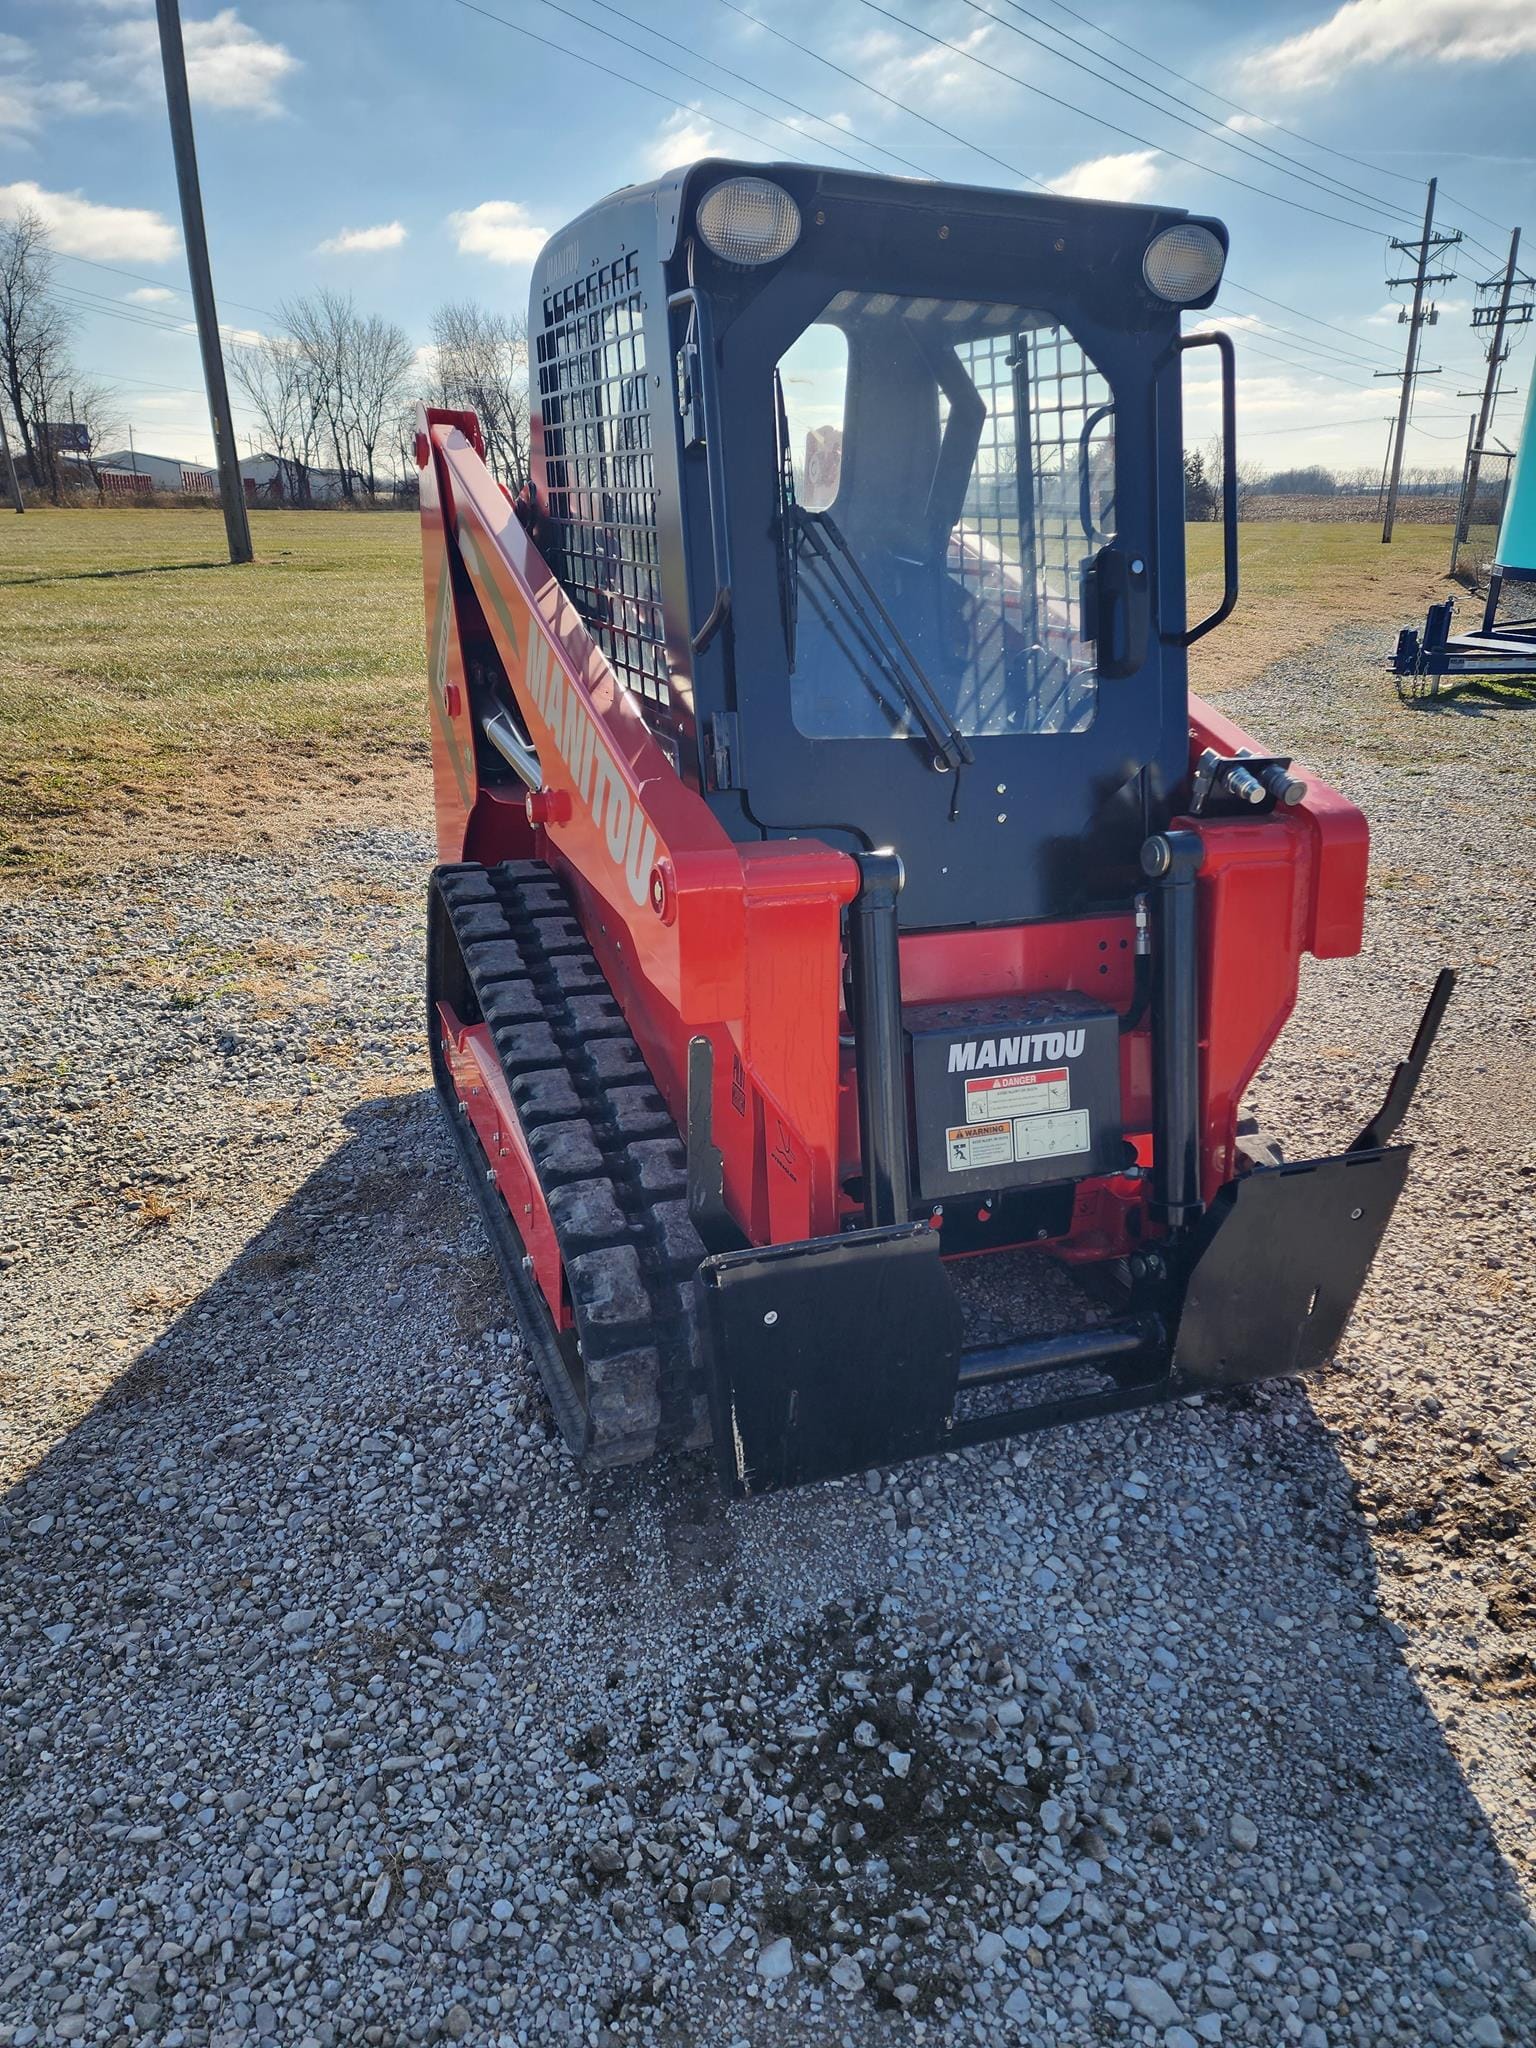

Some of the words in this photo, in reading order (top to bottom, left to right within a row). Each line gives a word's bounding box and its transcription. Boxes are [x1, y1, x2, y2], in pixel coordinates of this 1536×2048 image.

[525, 618, 656, 906] MANITOU
[948, 1029, 1086, 1073] MANITOU
[1002, 1075, 1037, 1087] DANGER
[964, 1125, 1004, 1138] WARNING
